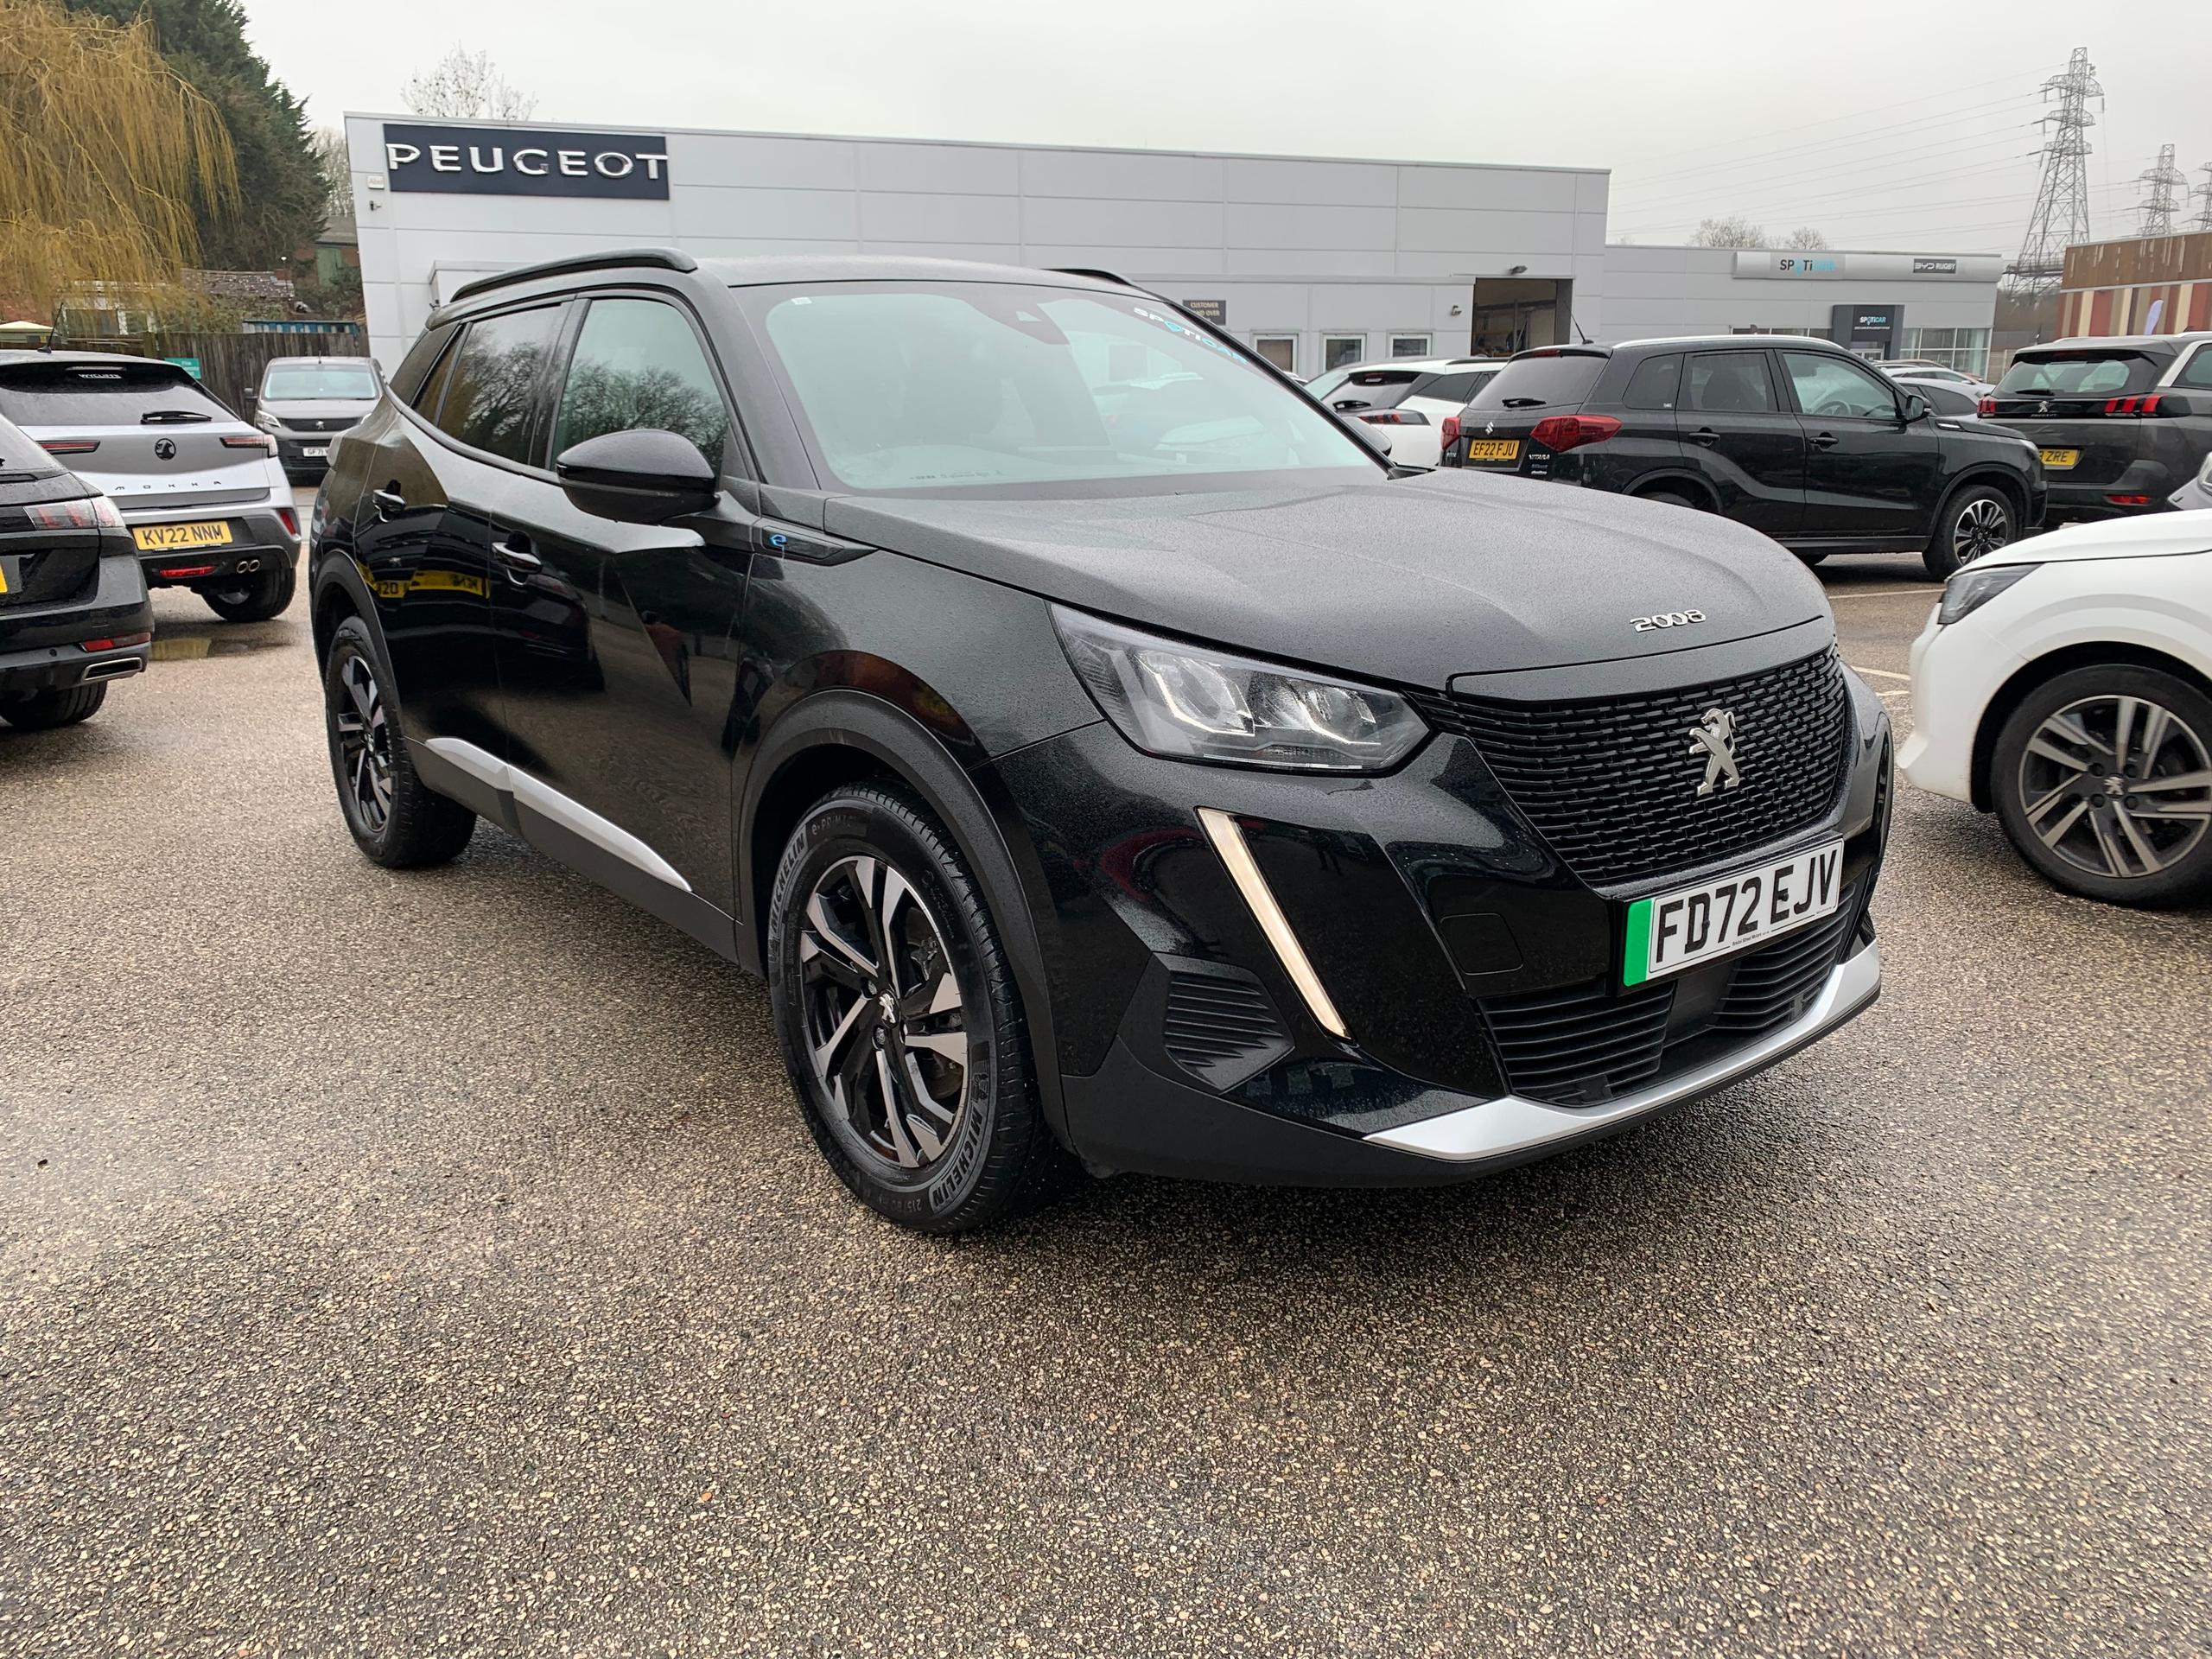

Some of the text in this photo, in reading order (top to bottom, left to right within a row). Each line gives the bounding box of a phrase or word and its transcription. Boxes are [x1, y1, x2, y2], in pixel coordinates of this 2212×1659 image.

[385, 143, 669, 181] PEUGEOT
[1472, 442, 1516, 456] EF22 FJU
[2045, 451, 2070, 462] ZRE
[142, 524, 224, 545] KV22 NNM
[1630, 608, 1707, 632] 2008
[769, 832, 806, 933] MICHELIN
[1656, 849, 1838, 963] FD72 EJV
[931, 1105, 983, 1208] MICHELIN
